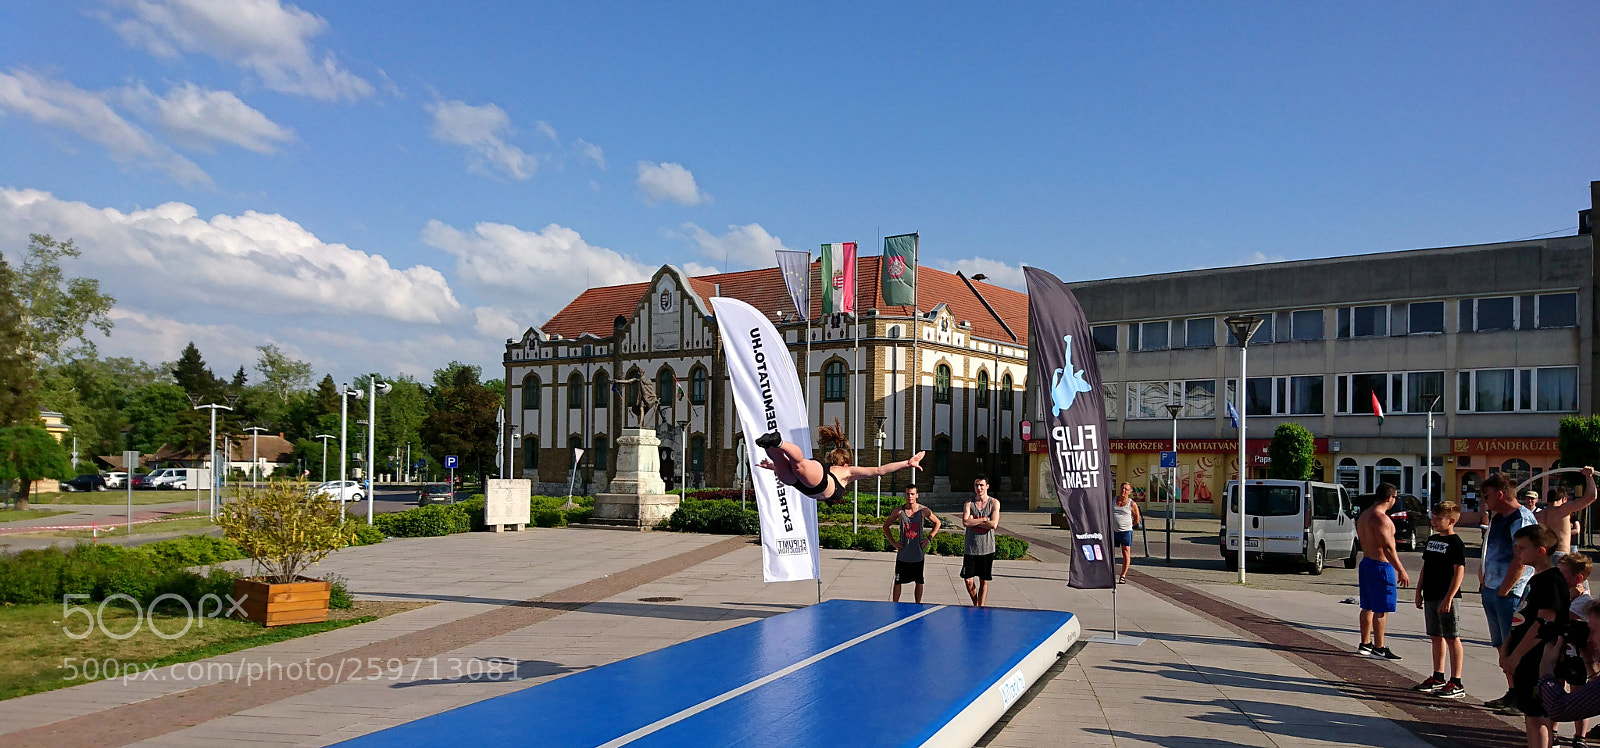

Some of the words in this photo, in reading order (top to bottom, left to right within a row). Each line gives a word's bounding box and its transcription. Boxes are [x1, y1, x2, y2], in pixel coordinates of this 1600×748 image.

[1110, 440, 1163, 450] PÍR-ÍRÓSZER
[1476, 439, 1560, 452] AJÁNDÉKÜZLE
[448, 457, 455, 466] P
